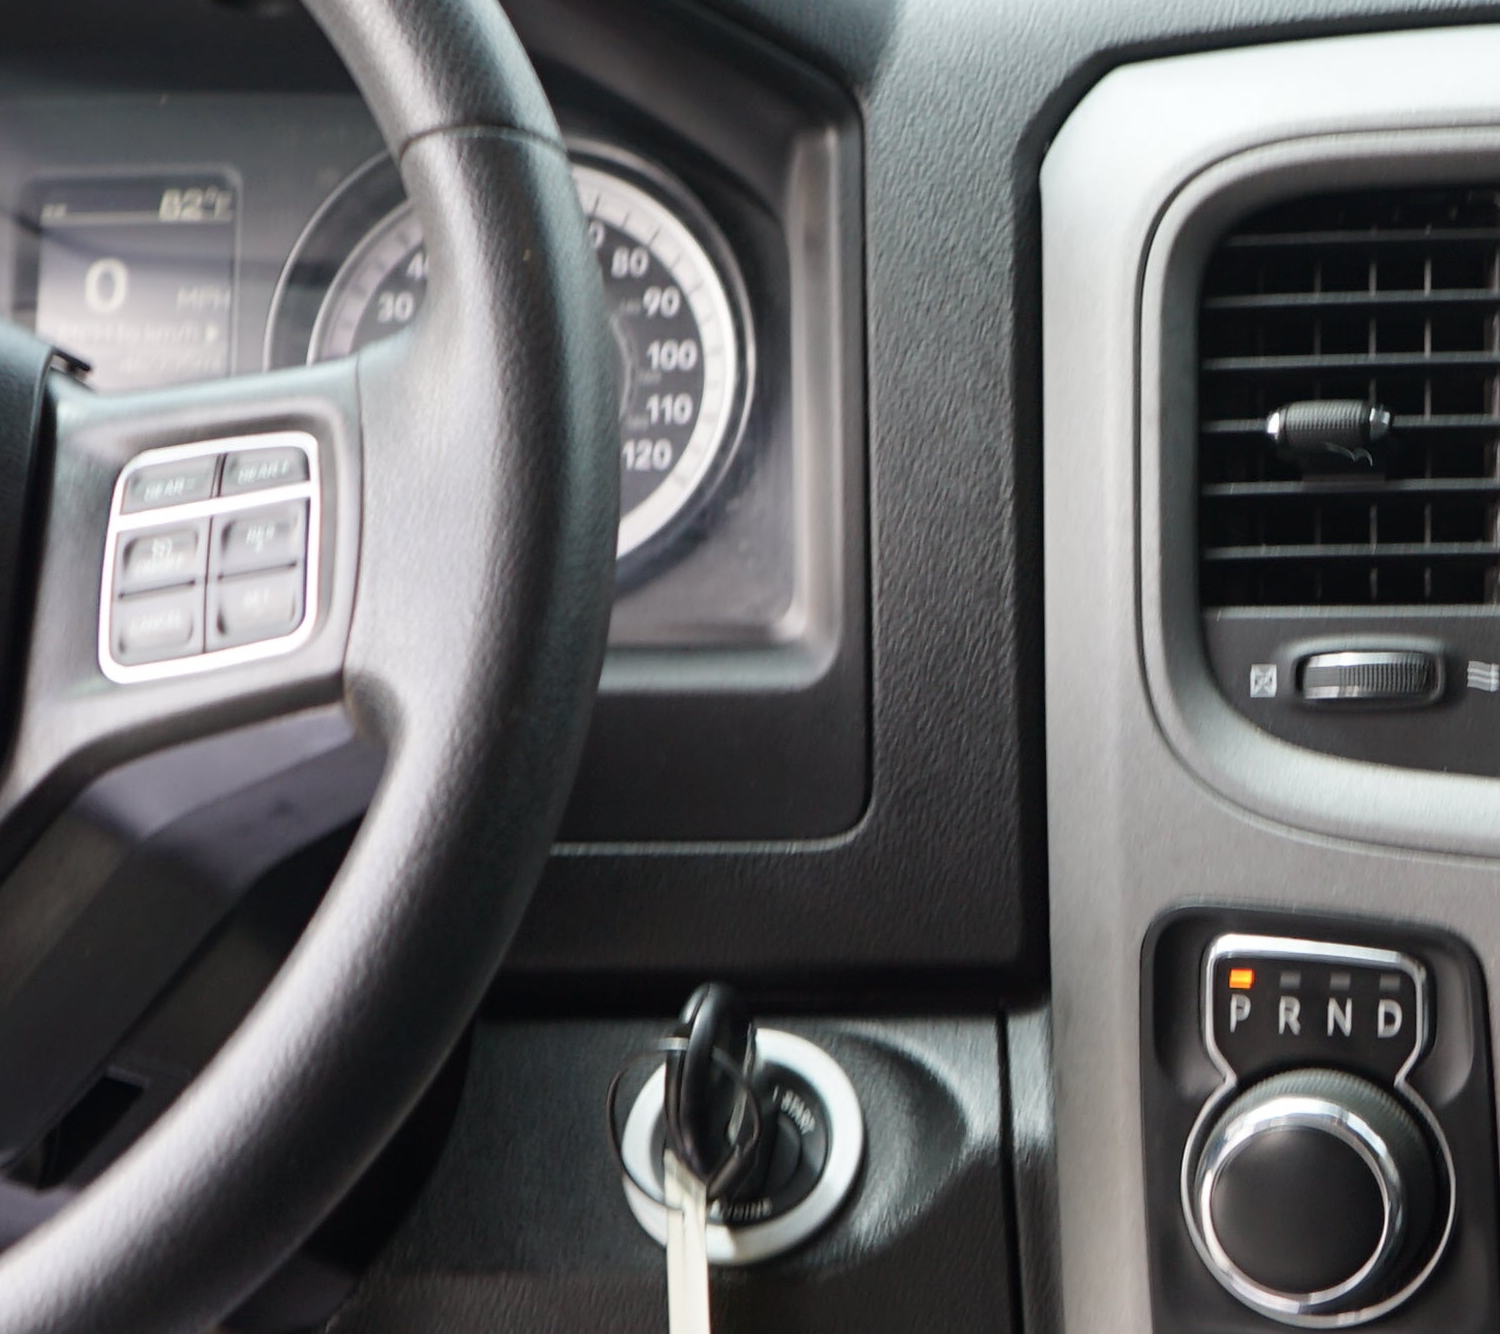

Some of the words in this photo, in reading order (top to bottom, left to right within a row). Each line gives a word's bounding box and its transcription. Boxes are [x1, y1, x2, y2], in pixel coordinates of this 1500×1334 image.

[612, 248, 649, 277] 80
[84, 257, 128, 314] 0
[377, 292, 415, 322] 30
[643, 287, 681, 318] 90
[646, 339, 697, 370] 100
[646, 393, 693, 424] 110
[622, 439, 672, 470] 120
[1229, 994, 1251, 1033] P
[1278, 995, 1301, 1035] R
[1327, 997, 1353, 1037] N
[1377, 998, 1403, 1038] D
